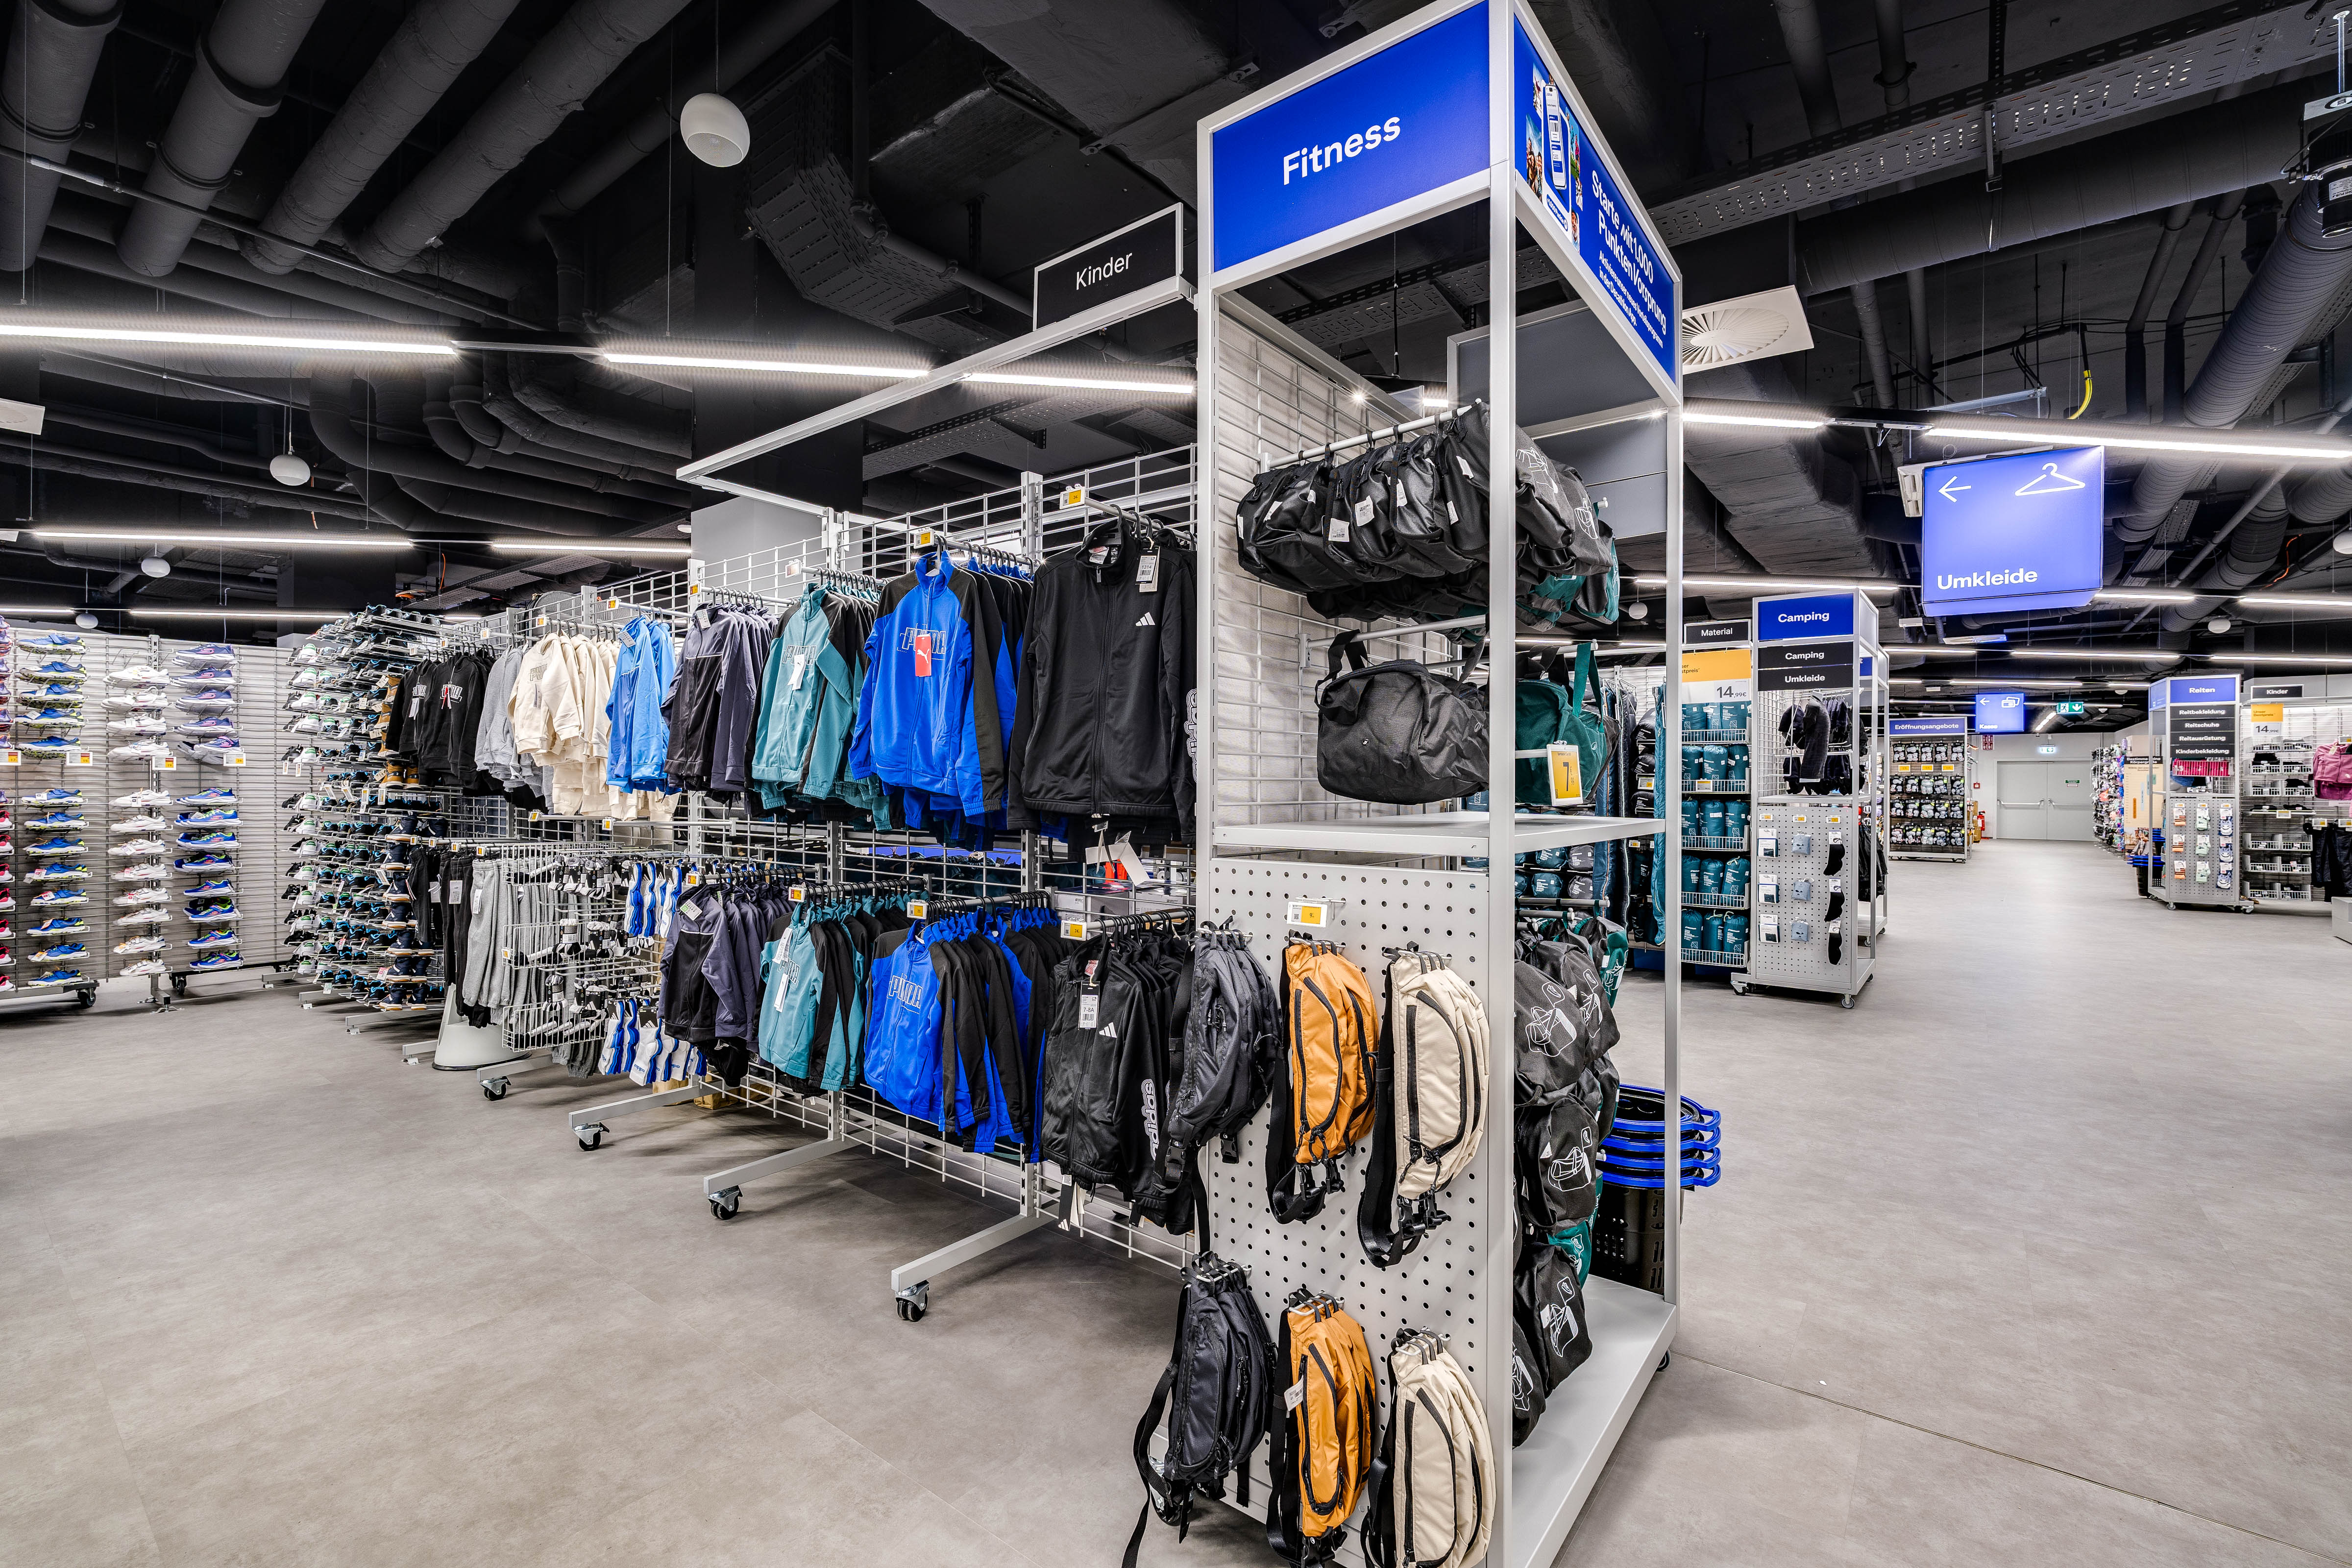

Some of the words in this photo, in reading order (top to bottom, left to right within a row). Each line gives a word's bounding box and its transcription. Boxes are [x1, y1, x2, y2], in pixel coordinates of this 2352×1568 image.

[1283, 116, 1401, 186] Fitness
[1592, 170, 1619, 230] Starte
[1620, 223, 1634, 253] mit
[1634, 238, 1653, 284] 1.000
[1076, 252, 1132, 290] Kinder
[1598, 209, 1633, 282] Punkten
[1633, 263, 1666, 335] Vorsprung
[1599, 266, 1603, 280] in
[1610, 283, 1629, 316] Decathlon
[1628, 308, 1637, 326] App.
[1599, 250, 1617, 284] Aktiviere
[1617, 277, 1627, 296] unser
[1627, 290, 1637, 310] neues
[1637, 302, 1664, 349] Vorteilsprogramm
[1937, 568, 2038, 590] Umkleide
[1701, 628, 1733, 637] Material
[1778, 611, 1830, 623] Camping
[1785, 651, 1825, 661] Camping
[1717, 686, 1746, 698] 14,99€
[1785, 674, 1825, 683] Umkleide
[888, 975, 923, 1009] PUMA
